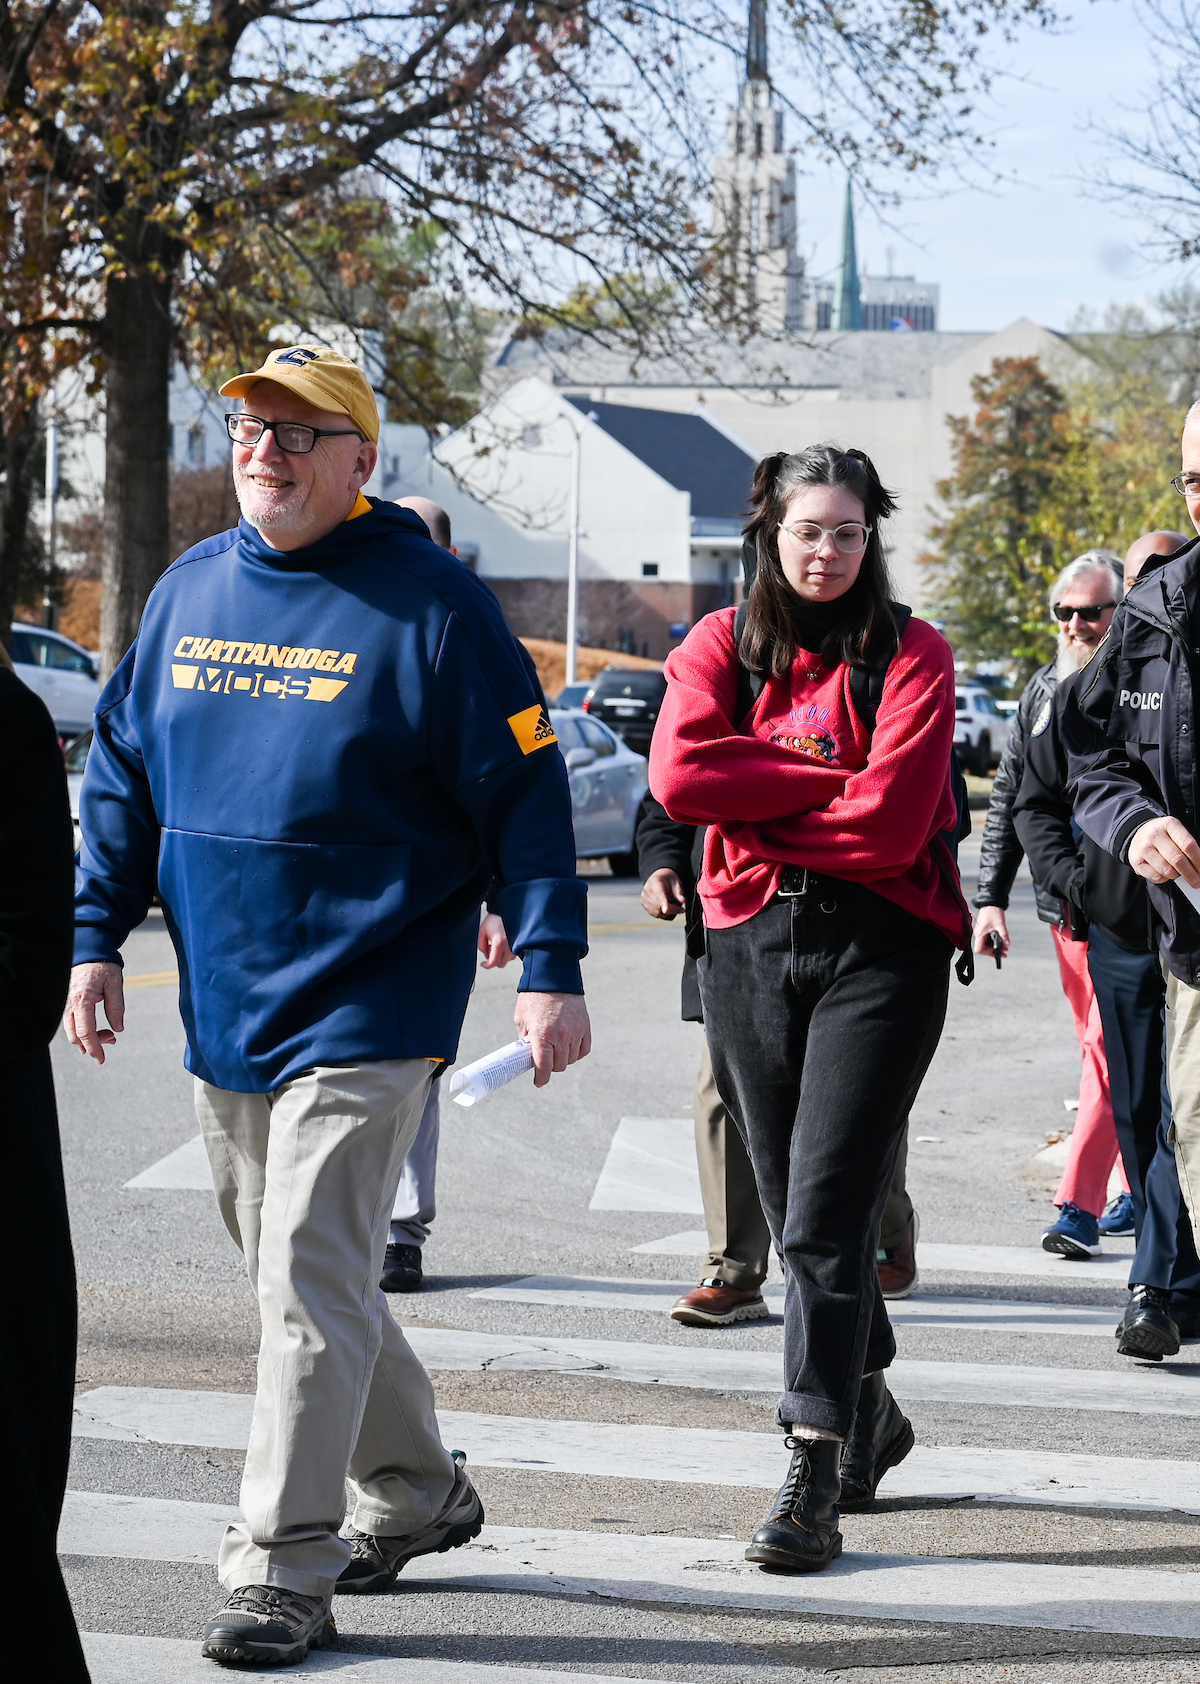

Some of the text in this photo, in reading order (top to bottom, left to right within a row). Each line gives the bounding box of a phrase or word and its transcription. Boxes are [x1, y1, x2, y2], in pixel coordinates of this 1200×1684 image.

[274, 347, 321, 367] C
[173, 635, 358, 675] CHATTANOOGA
[191, 664, 315, 702] MOCS
[789, 704, 830, 723] POOH
